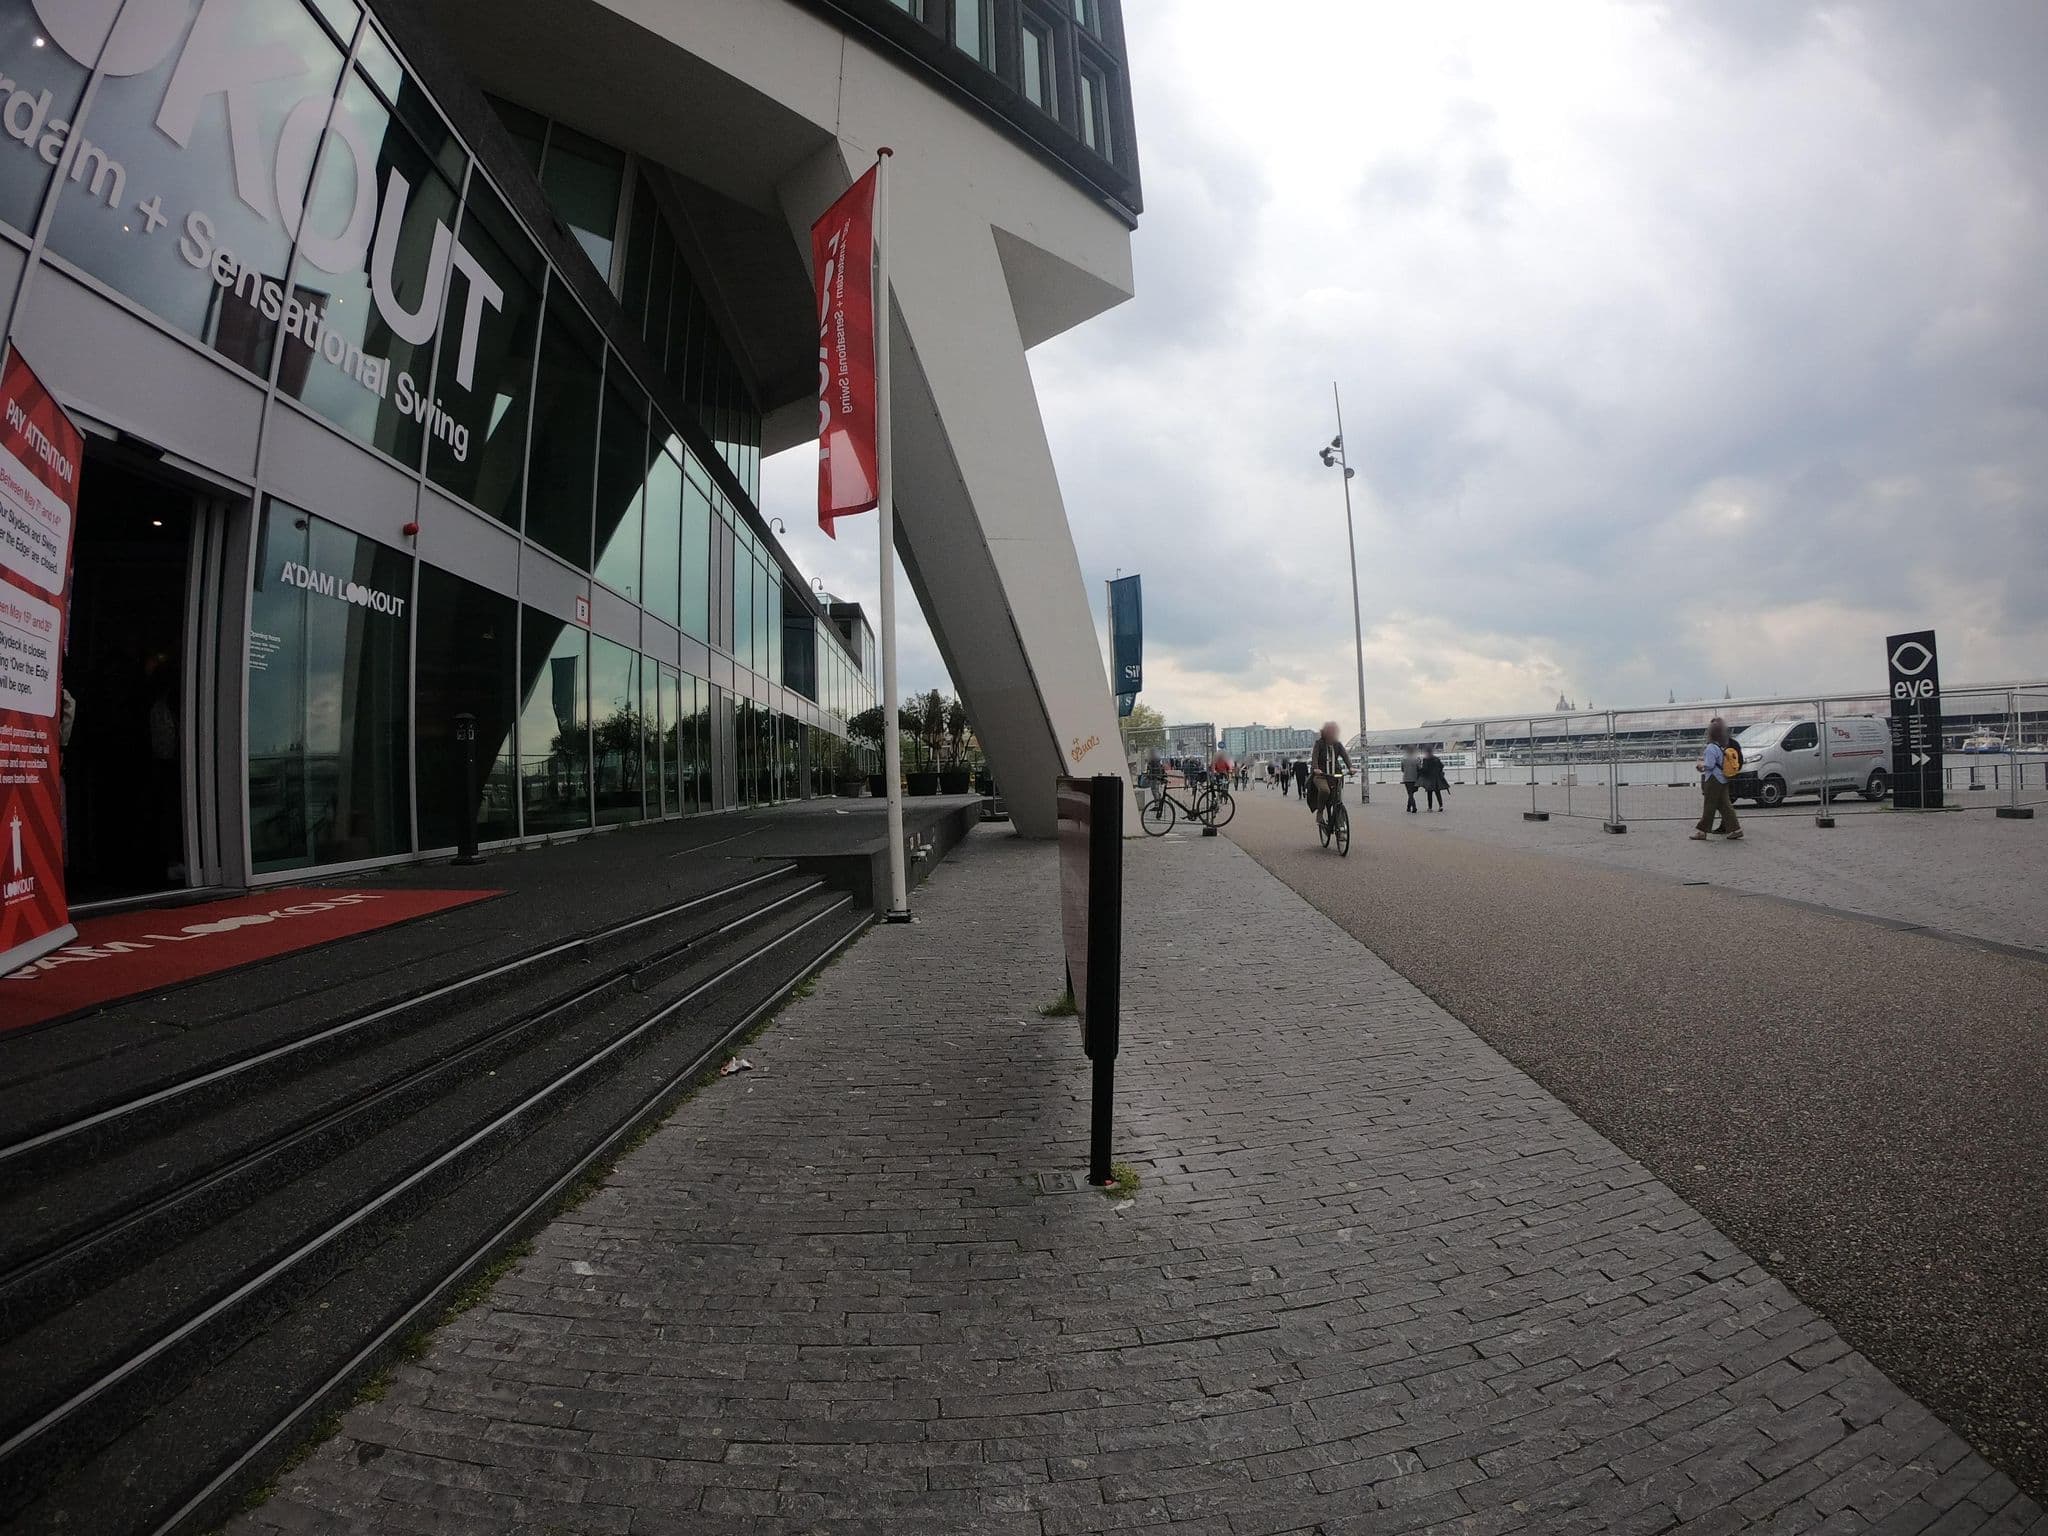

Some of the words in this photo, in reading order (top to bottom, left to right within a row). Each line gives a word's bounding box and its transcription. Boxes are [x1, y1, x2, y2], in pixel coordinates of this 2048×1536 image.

[138, 196, 168, 233] +
[181, 211, 391, 399] Sensational
[395, 371, 469, 462] Swing
[6, 397, 27, 434] PAY
[24, 420, 73, 484] ATTENTION
[0, 467, 24, 498] Between
[9, 509, 31, 537] Skydeck
[41, 534, 57, 558] Swing
[338, 579, 406, 618] LOOKOUT
[1894, 678, 1934, 706] eye
[4, 877, 35, 899] LOOKOUT
[142, 893, 385, 942] LOOKOUT
